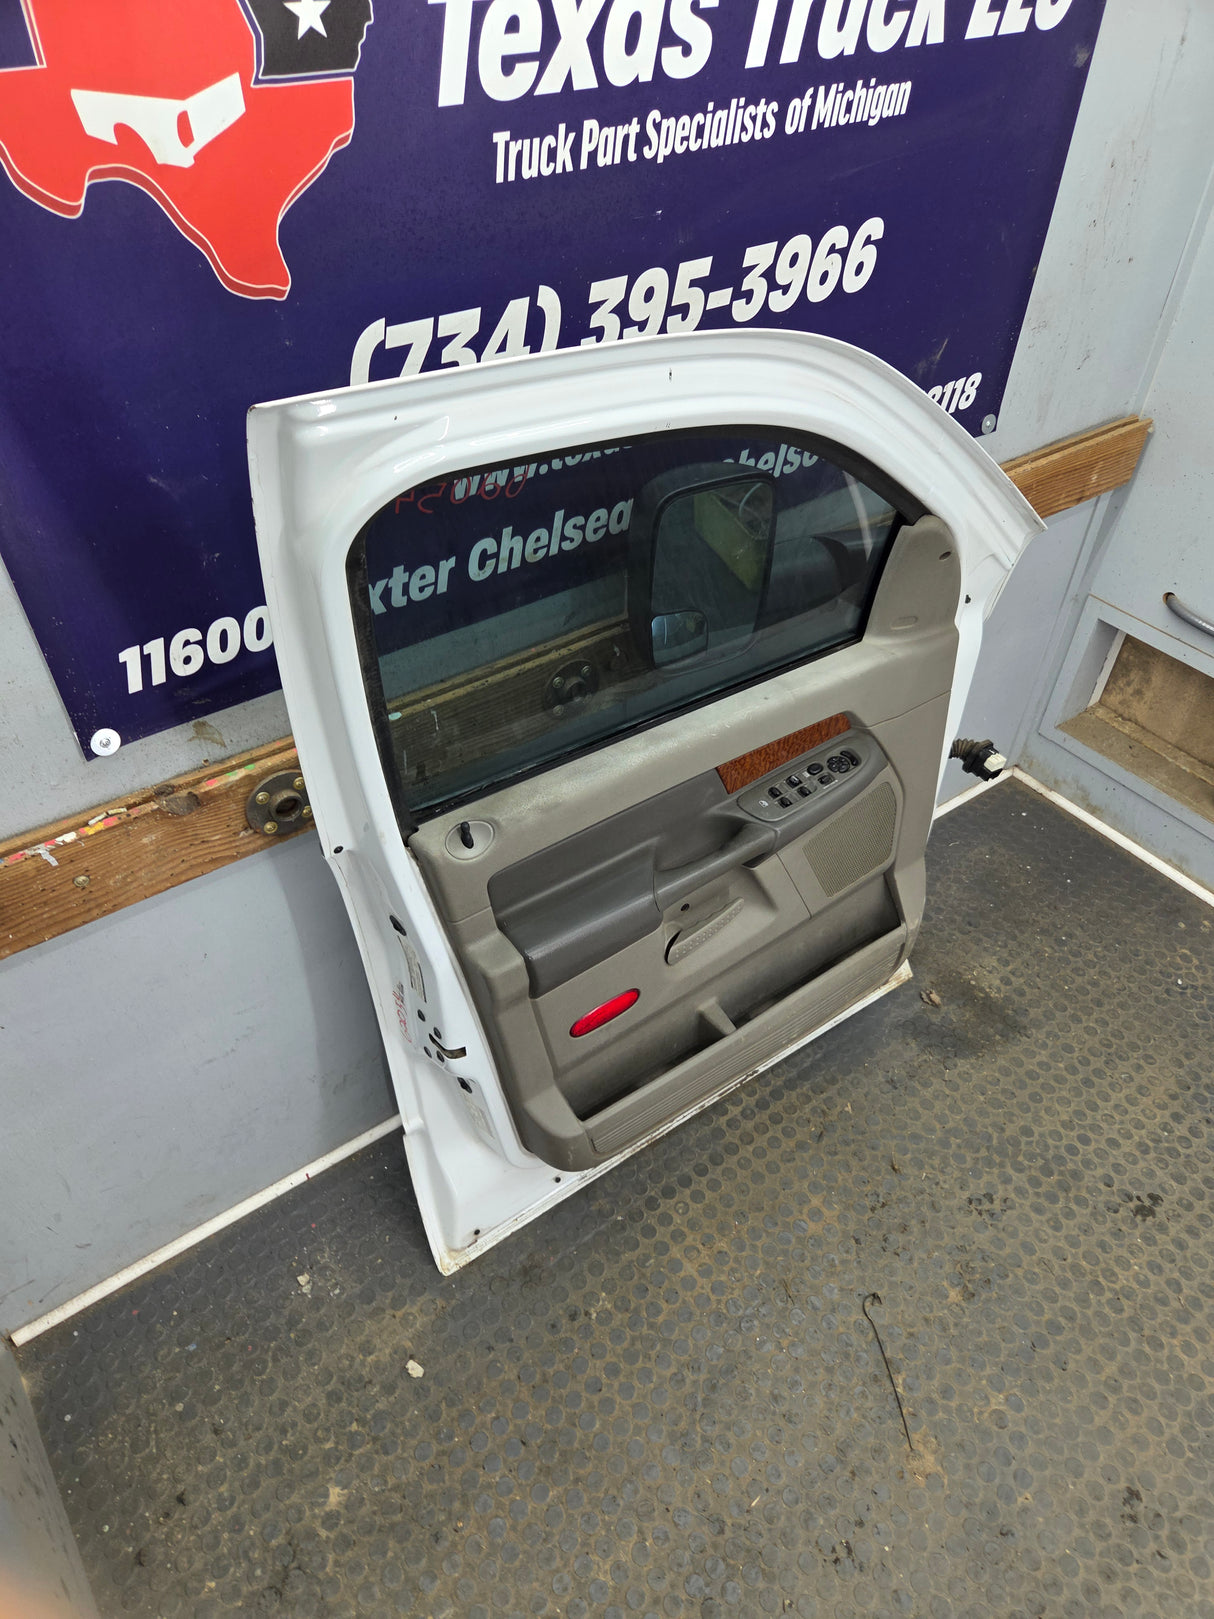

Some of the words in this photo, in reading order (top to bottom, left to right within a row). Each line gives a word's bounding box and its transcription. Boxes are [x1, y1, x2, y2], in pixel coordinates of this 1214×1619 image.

[428, 0, 719, 107] Texas
[493, 123, 576, 184] Truck
[580, 116, 640, 171] Part
[643, 98, 779, 164] Specialists
[785, 87, 815, 136] of
[811, 78, 912, 131] Michigan
[350, 285, 562, 386] (734)
[580, 217, 885, 346] 395-3966
[118, 605, 275, 695] 11600
[468, 497, 634, 582] Chelsea
